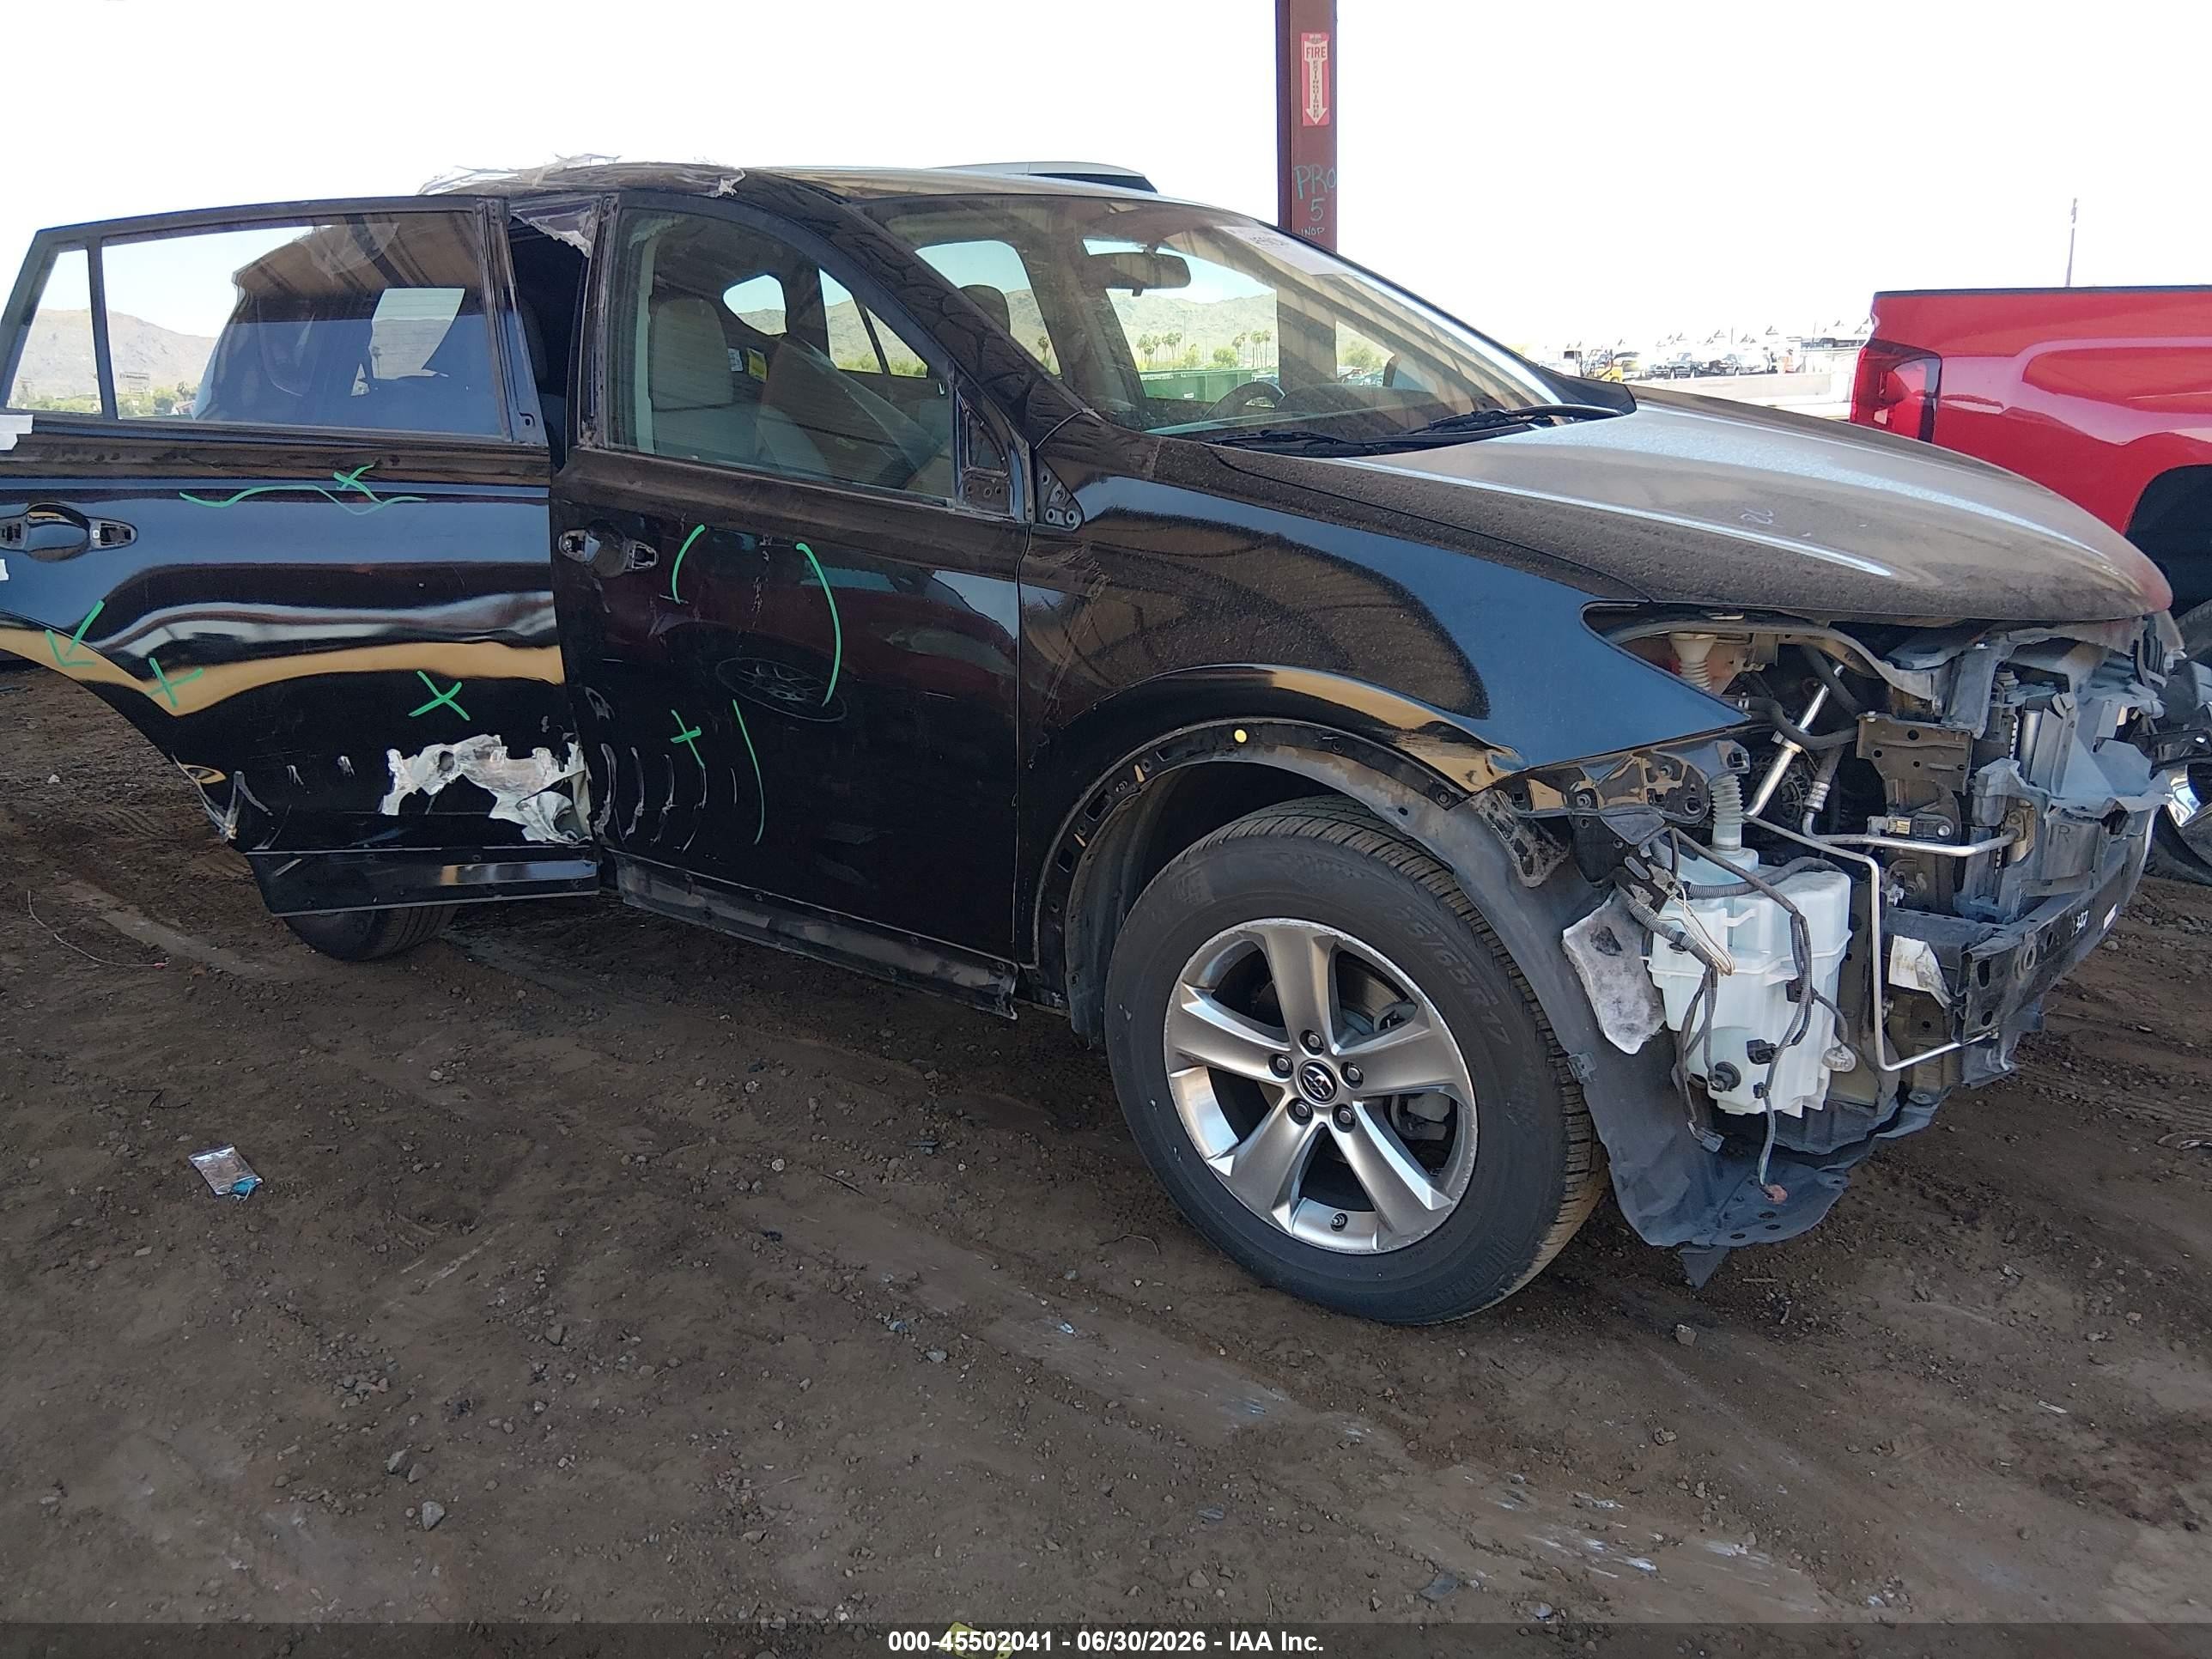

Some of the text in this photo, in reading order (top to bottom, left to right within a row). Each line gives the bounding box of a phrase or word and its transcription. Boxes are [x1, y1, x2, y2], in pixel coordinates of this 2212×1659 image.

[1306, 46, 1327, 58] FIRE
[1293, 163, 1336, 200] PRO
[1310, 198, 1326, 222] 5
